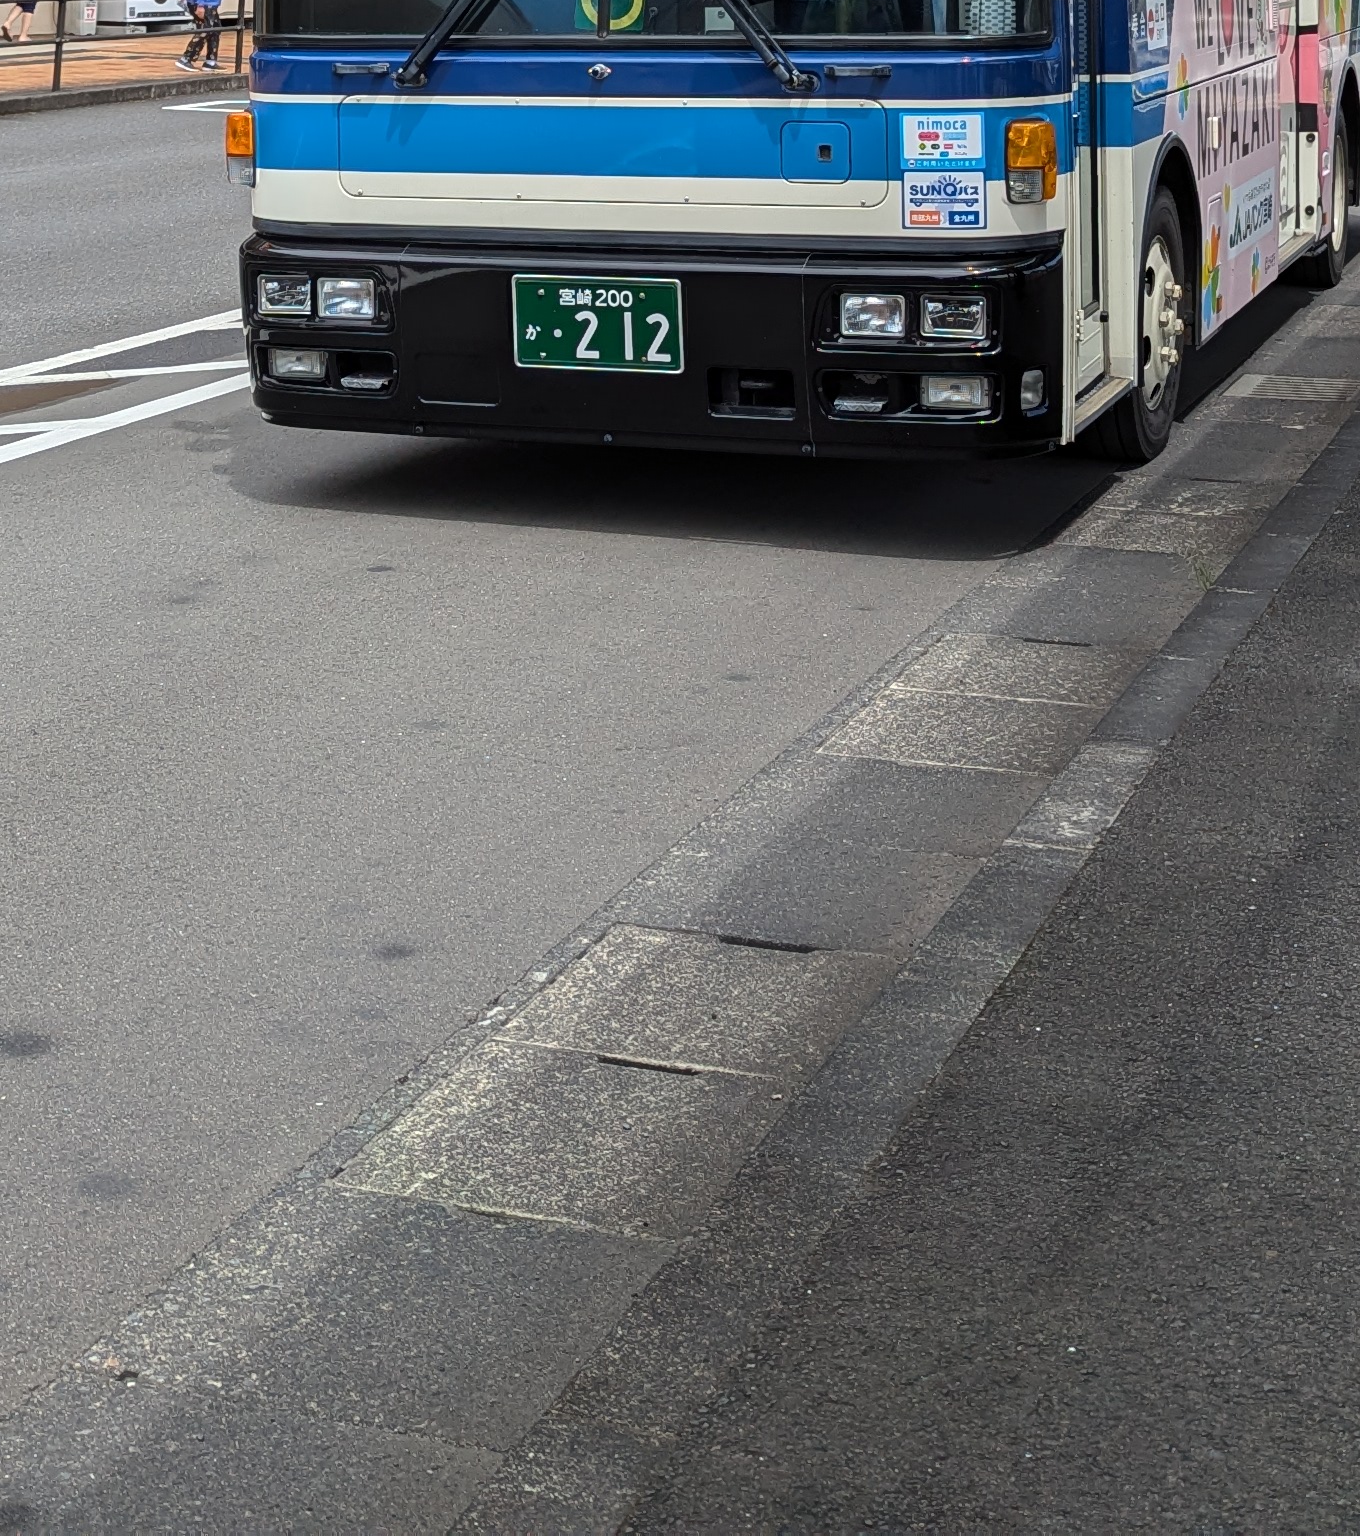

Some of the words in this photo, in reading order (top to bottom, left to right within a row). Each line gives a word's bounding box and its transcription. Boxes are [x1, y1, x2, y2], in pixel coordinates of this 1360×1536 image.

[917, 117, 967, 130] nimoca
[1196, 62, 1275, 180] MIYAZAKI
[525, 324, 541, 341] か
